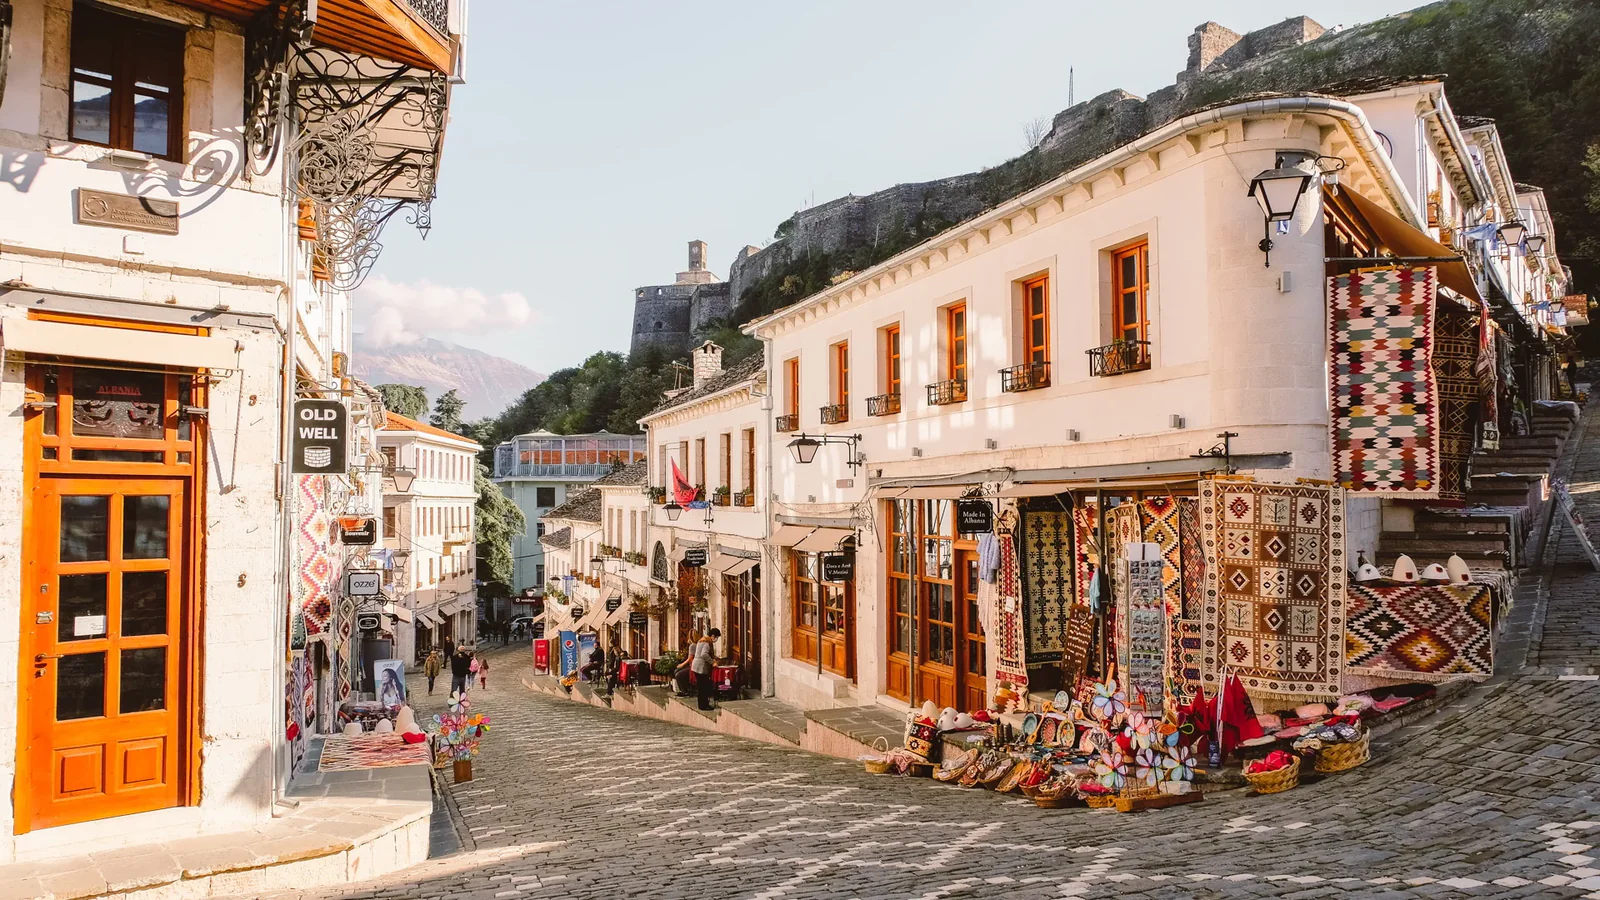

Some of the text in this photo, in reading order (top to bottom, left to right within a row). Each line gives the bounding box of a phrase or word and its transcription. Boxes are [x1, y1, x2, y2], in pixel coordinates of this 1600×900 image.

[98, 385, 141, 395] ALBANIA
[300, 408, 337, 421] OLD
[299, 427, 338, 440] WELL
